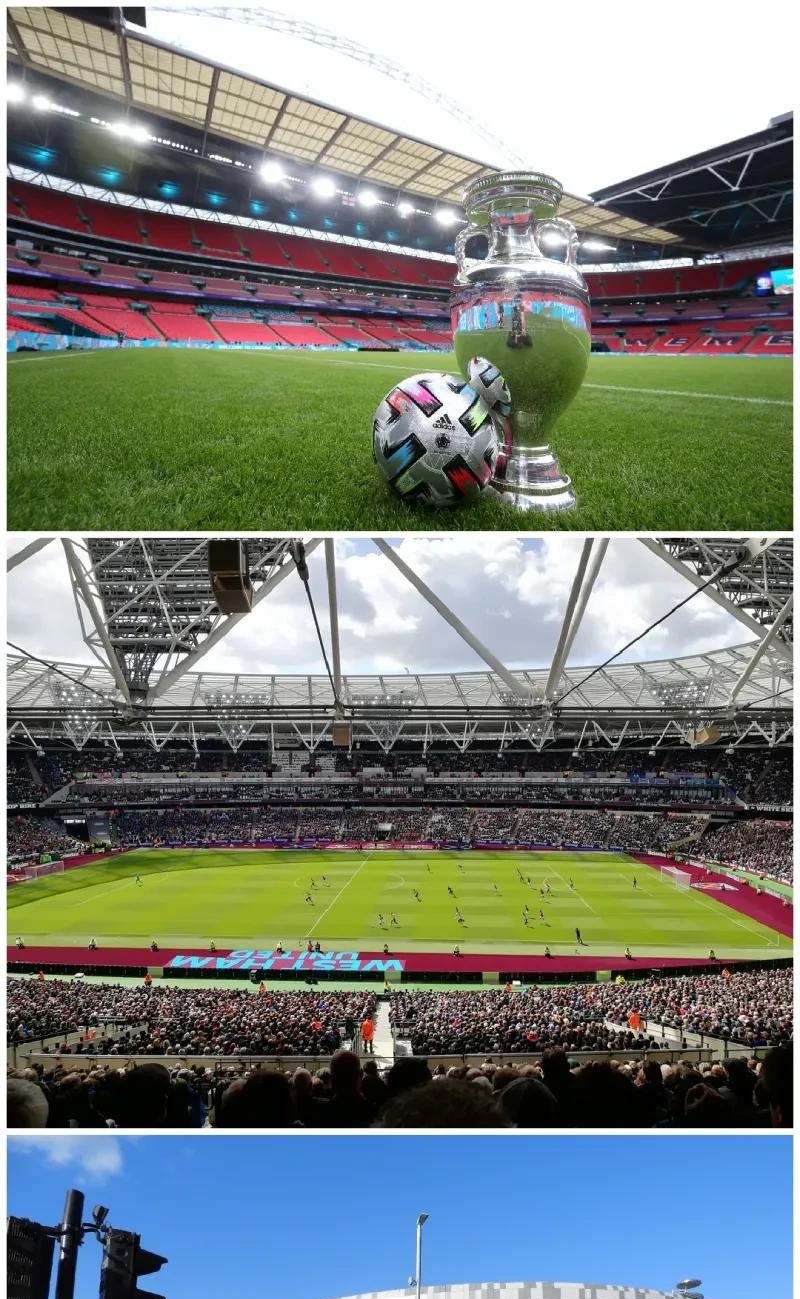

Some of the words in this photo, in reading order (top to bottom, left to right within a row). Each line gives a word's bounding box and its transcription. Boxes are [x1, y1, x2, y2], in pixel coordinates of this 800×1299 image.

[229, 950, 359, 960] UNITED
[171, 955, 275, 969] HAM
[292, 959, 405, 971] WEST
